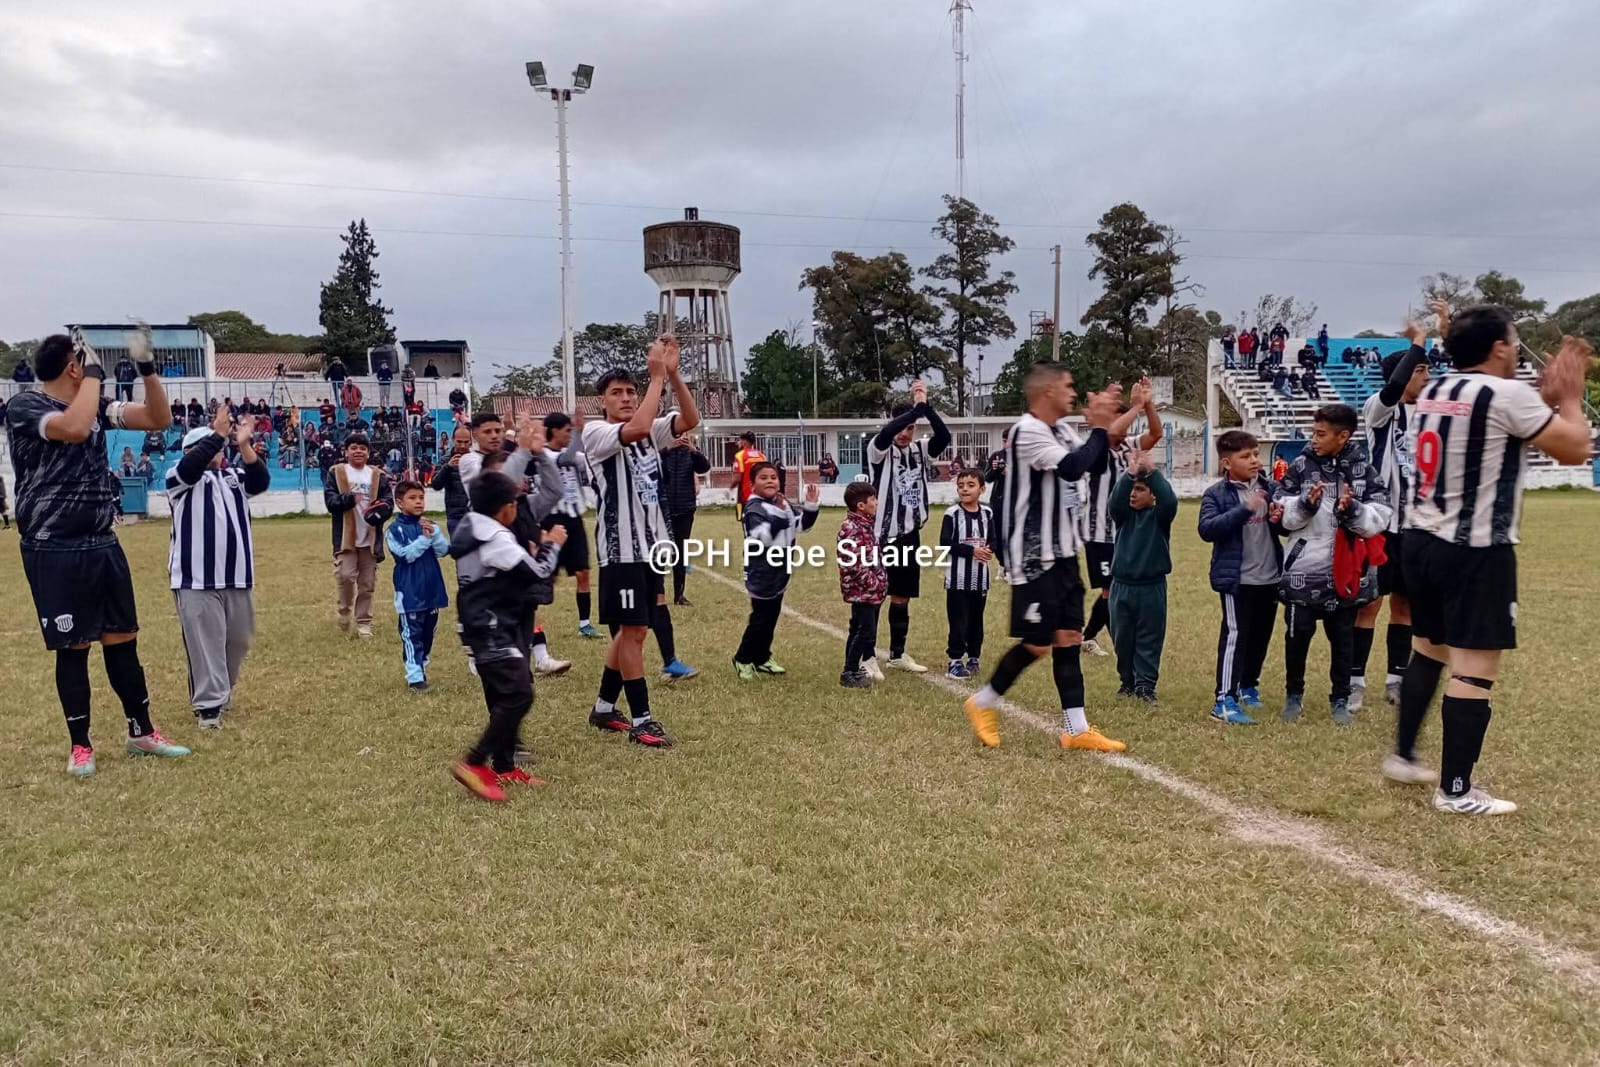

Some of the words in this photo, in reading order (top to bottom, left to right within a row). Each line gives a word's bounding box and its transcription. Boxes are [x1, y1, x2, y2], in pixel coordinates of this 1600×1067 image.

[1416, 430, 1442, 499] 9
[1100, 561, 1110, 577] 5
[619, 588, 635, 609] 11
[1024, 602, 1042, 624] 4
